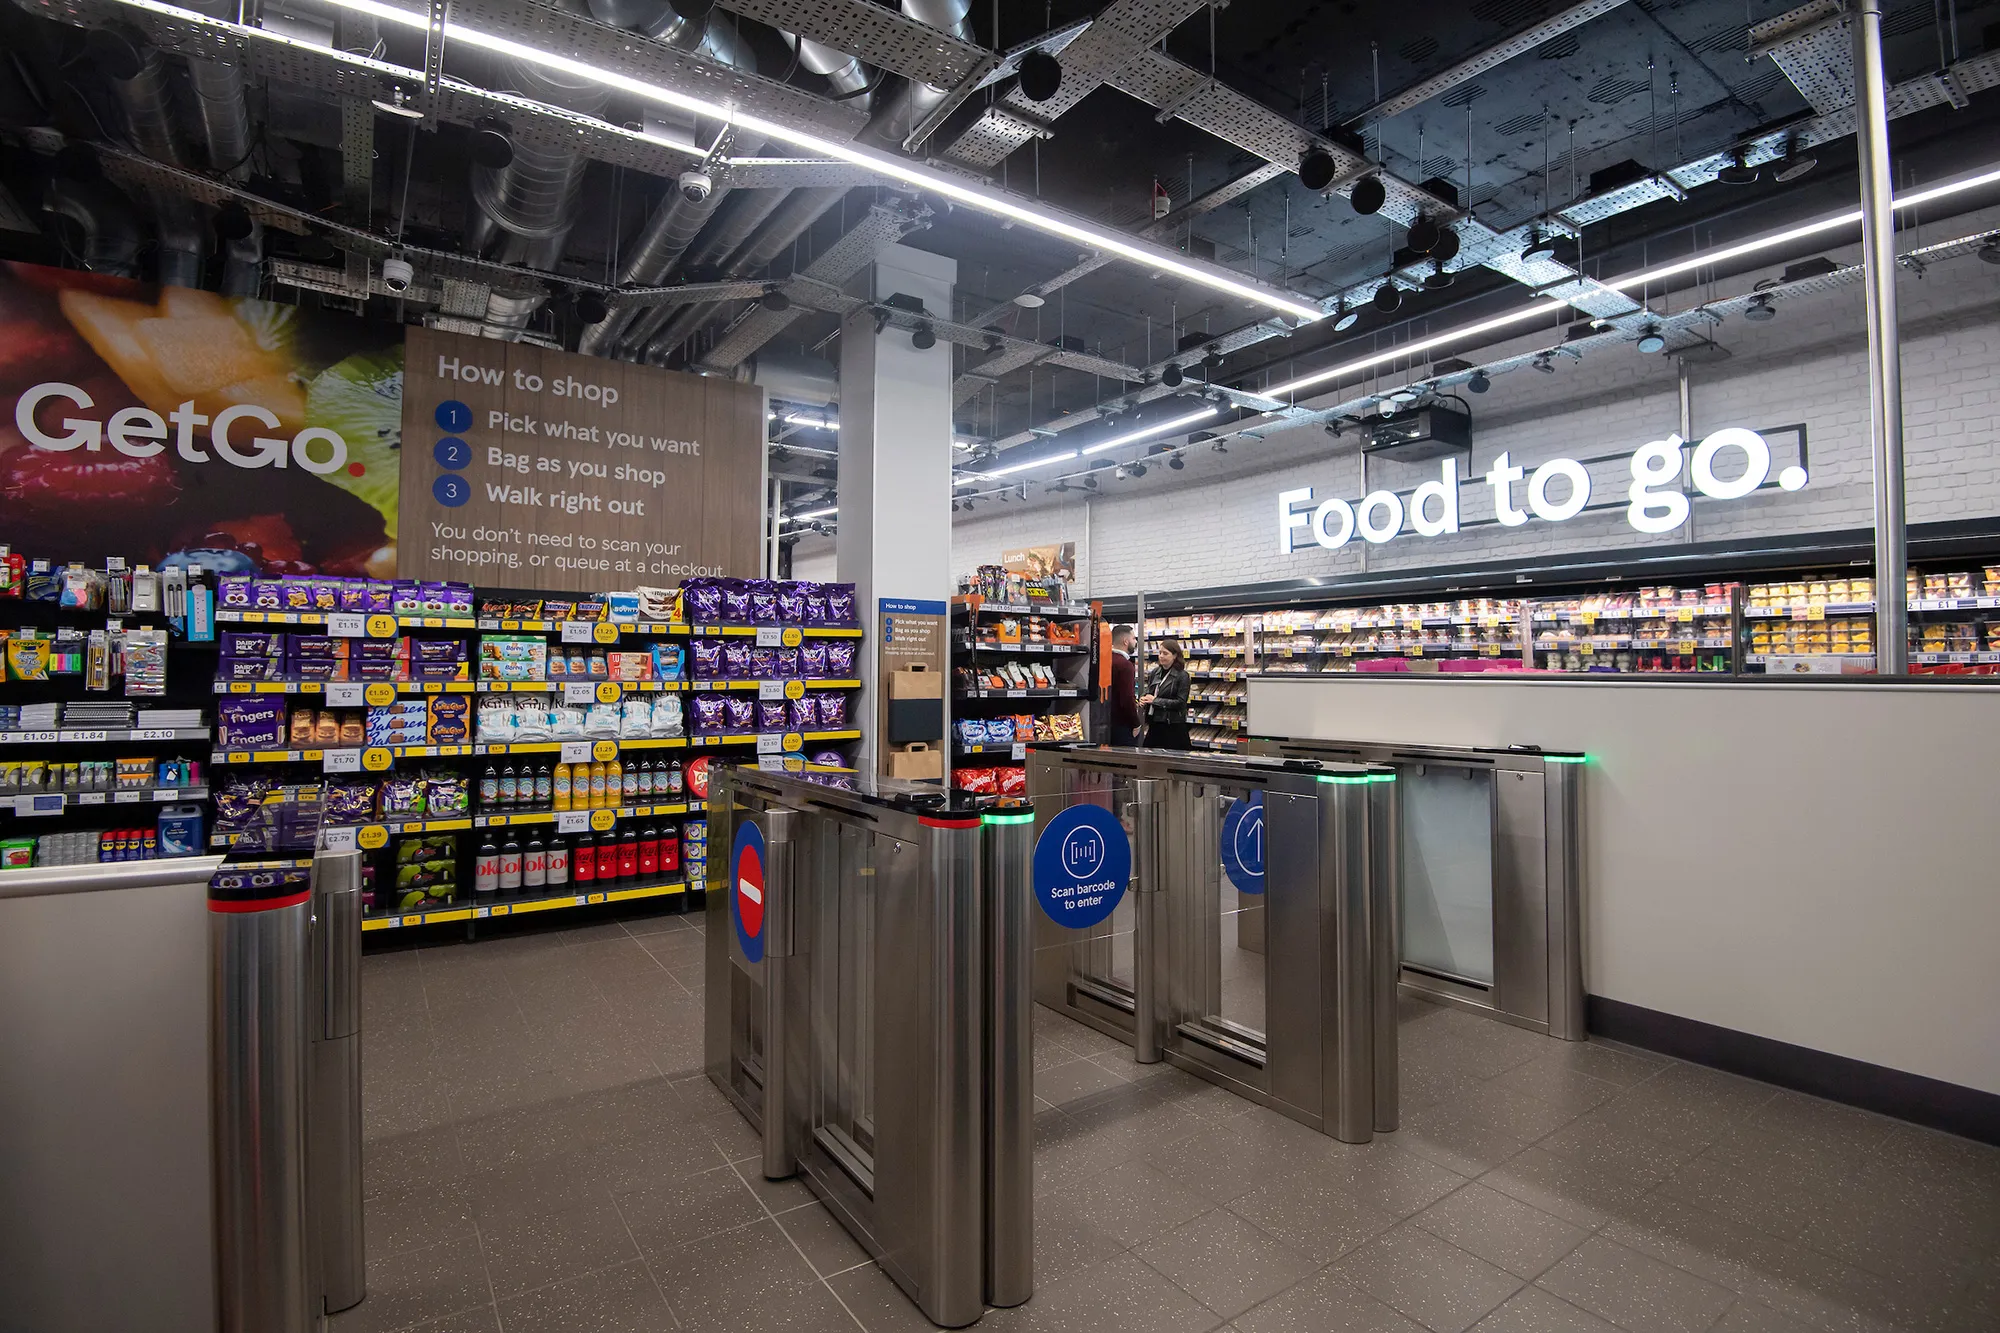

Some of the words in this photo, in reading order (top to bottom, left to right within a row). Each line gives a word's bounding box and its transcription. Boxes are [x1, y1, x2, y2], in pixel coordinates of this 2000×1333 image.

[438, 355, 505, 387] How
[512, 368, 544, 393] to
[552, 376, 620, 408] shop
[15, 382, 366, 478] GetGo.
[450, 410, 456, 424] 1
[488, 410, 537, 436] Pick
[544, 418, 600, 443] what
[606, 430, 644, 450] you
[650, 434, 700, 457] want
[448, 447, 458, 462] 2
[488, 447, 530, 475] Bag
[536, 456, 562, 474] as
[567, 461, 608, 480] you
[614, 463, 666, 488] shop
[446, 484, 457, 498] 3
[486, 482, 542, 508] Walk
[550, 490, 602, 514] right
[608, 498, 644, 516] out
[1278, 458, 1459, 554] Food
[1486, 450, 1592, 528] to
[1628, 426, 1808, 534] go.
[432, 522, 466, 542] You
[528, 528, 573, 550] need
[578, 534, 596, 550] to
[602, 540, 640, 556] scan
[646, 541, 682, 558] your
[431, 546, 523, 570] shopping,
[529, 554, 550, 567] or
[554, 556, 610, 572] queue
[616, 558, 632, 574] at
[636, 563, 646, 574] a
[651, 560, 728, 579] checkout.
[1004, 552, 1026, 564] Lunch
[674, 608, 681, 618] 4
[1680, 608, 1691, 616] £3
[1681, 641, 1692, 650] £3
[231, 711, 274, 723] fingers
[1051, 888, 1074, 898] Scan
[1077, 880, 1115, 894] barcode
[1064, 900, 1075, 909] to
[1078, 896, 1102, 907] enter
